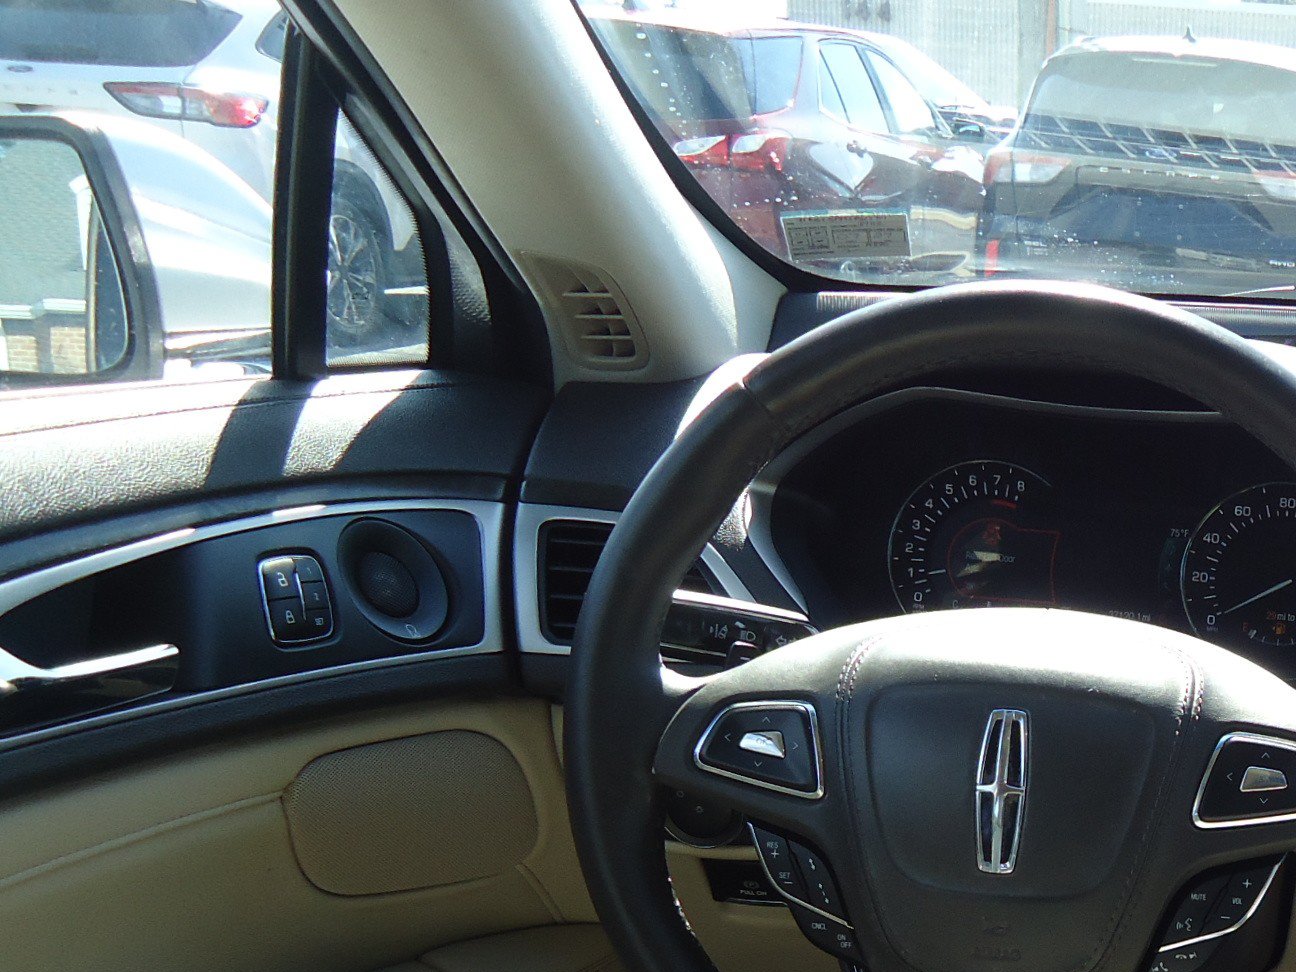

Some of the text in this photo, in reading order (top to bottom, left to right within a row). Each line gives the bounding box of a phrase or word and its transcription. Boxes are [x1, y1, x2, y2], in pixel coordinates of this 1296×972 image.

[969, 475, 977, 486] 6
[994, 475, 1002, 485] 7
[945, 484, 954, 494] 5
[1017, 481, 1025, 492] 8
[925, 498, 934, 509] 4
[1279, 497, 1296, 509] 80
[1234, 506, 1251, 517] 60
[912, 519, 921, 531] 3
[1202, 532, 1220, 544] 40
[905, 543, 914, 553] 2
[1192, 572, 1209, 583] 20
[913, 591, 923, 602] 0
[1207, 614, 1216, 626] 0
[767, 841, 779, 850] RES
[778, 872, 790, 880] SET
[1190, 892, 1207, 901] MUTE
[1232, 897, 1243, 906] VOL
[837, 934, 847, 942] ON
[840, 941, 852, 949] OFF
